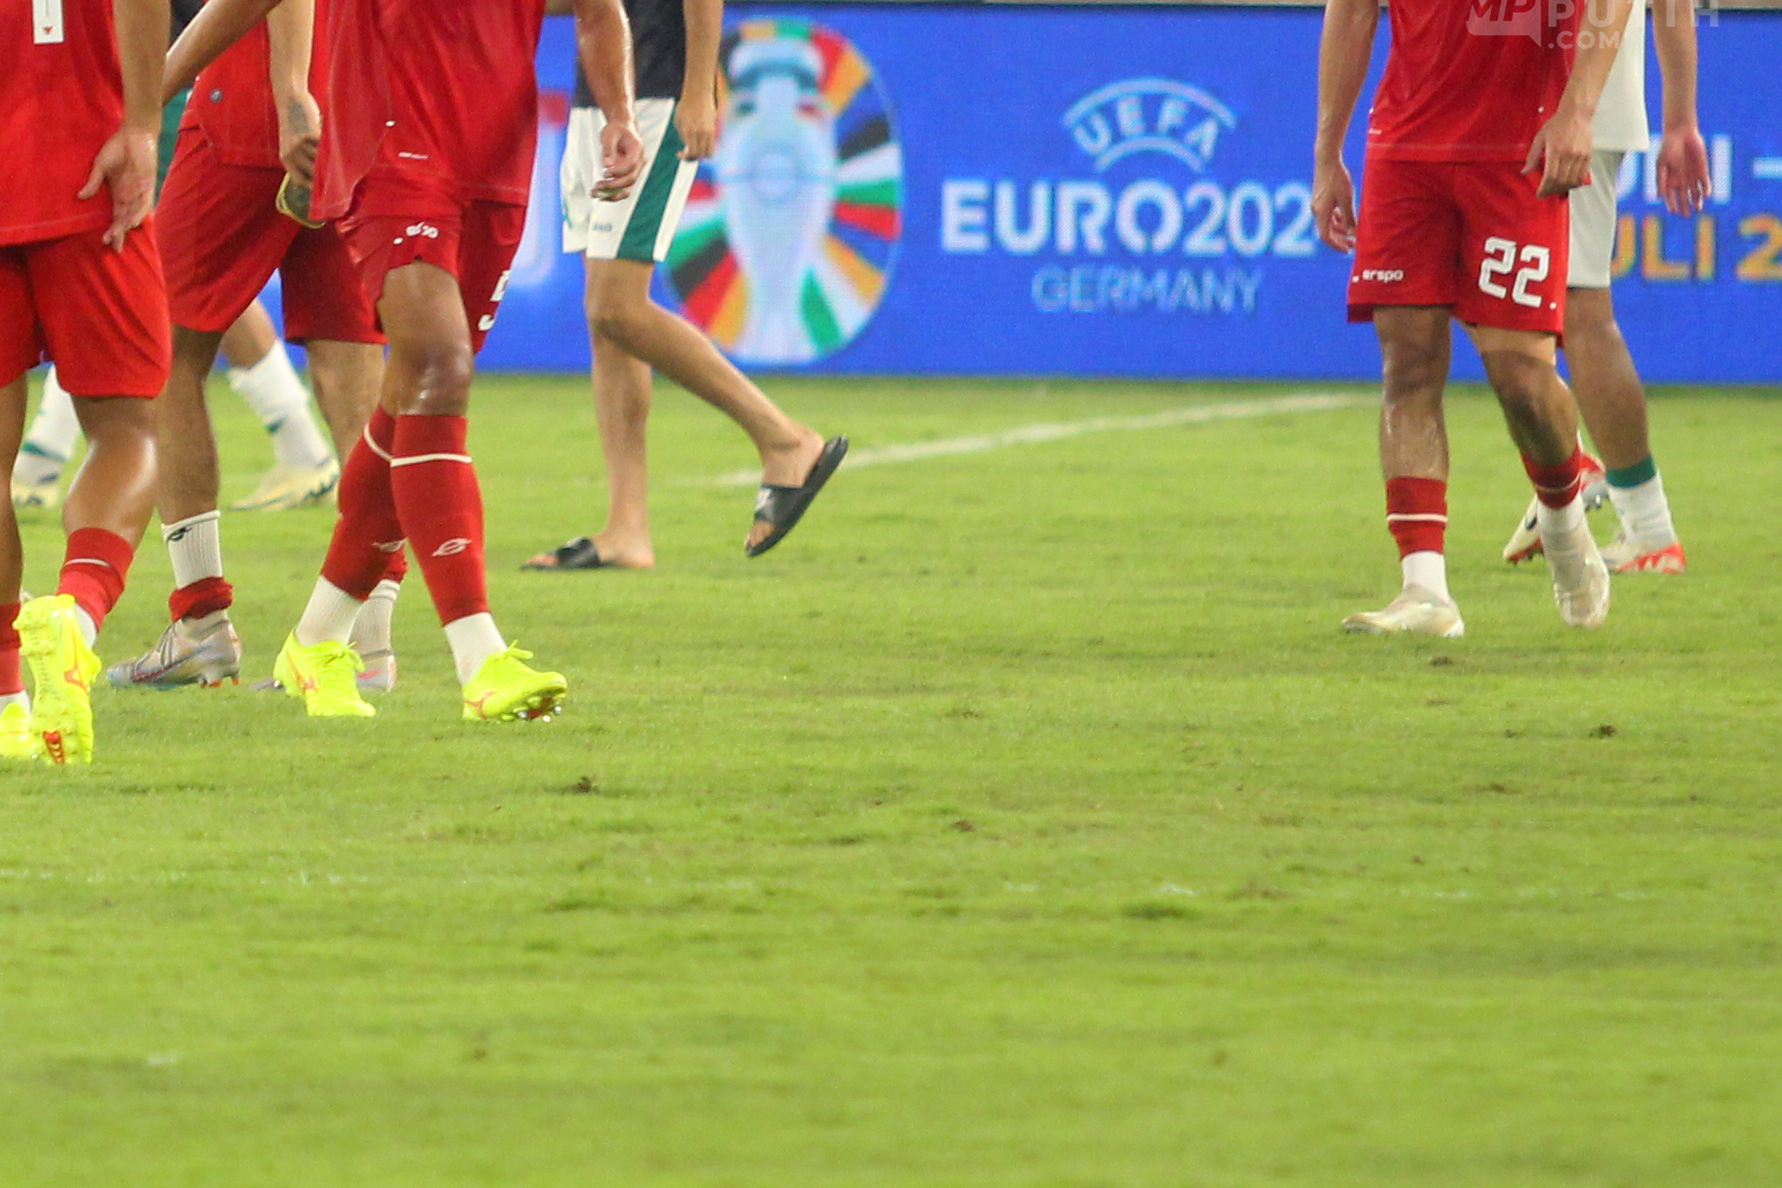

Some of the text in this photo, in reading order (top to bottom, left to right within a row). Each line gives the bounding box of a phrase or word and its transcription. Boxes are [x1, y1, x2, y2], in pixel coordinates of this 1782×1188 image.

[1072, 96, 1218, 161] UEFA
[940, 178, 1318, 257] EURO202
[1031, 263, 1264, 314] GERMANY
[1362, 268, 1404, 283] erspo
[1478, 236, 1550, 309] 22
